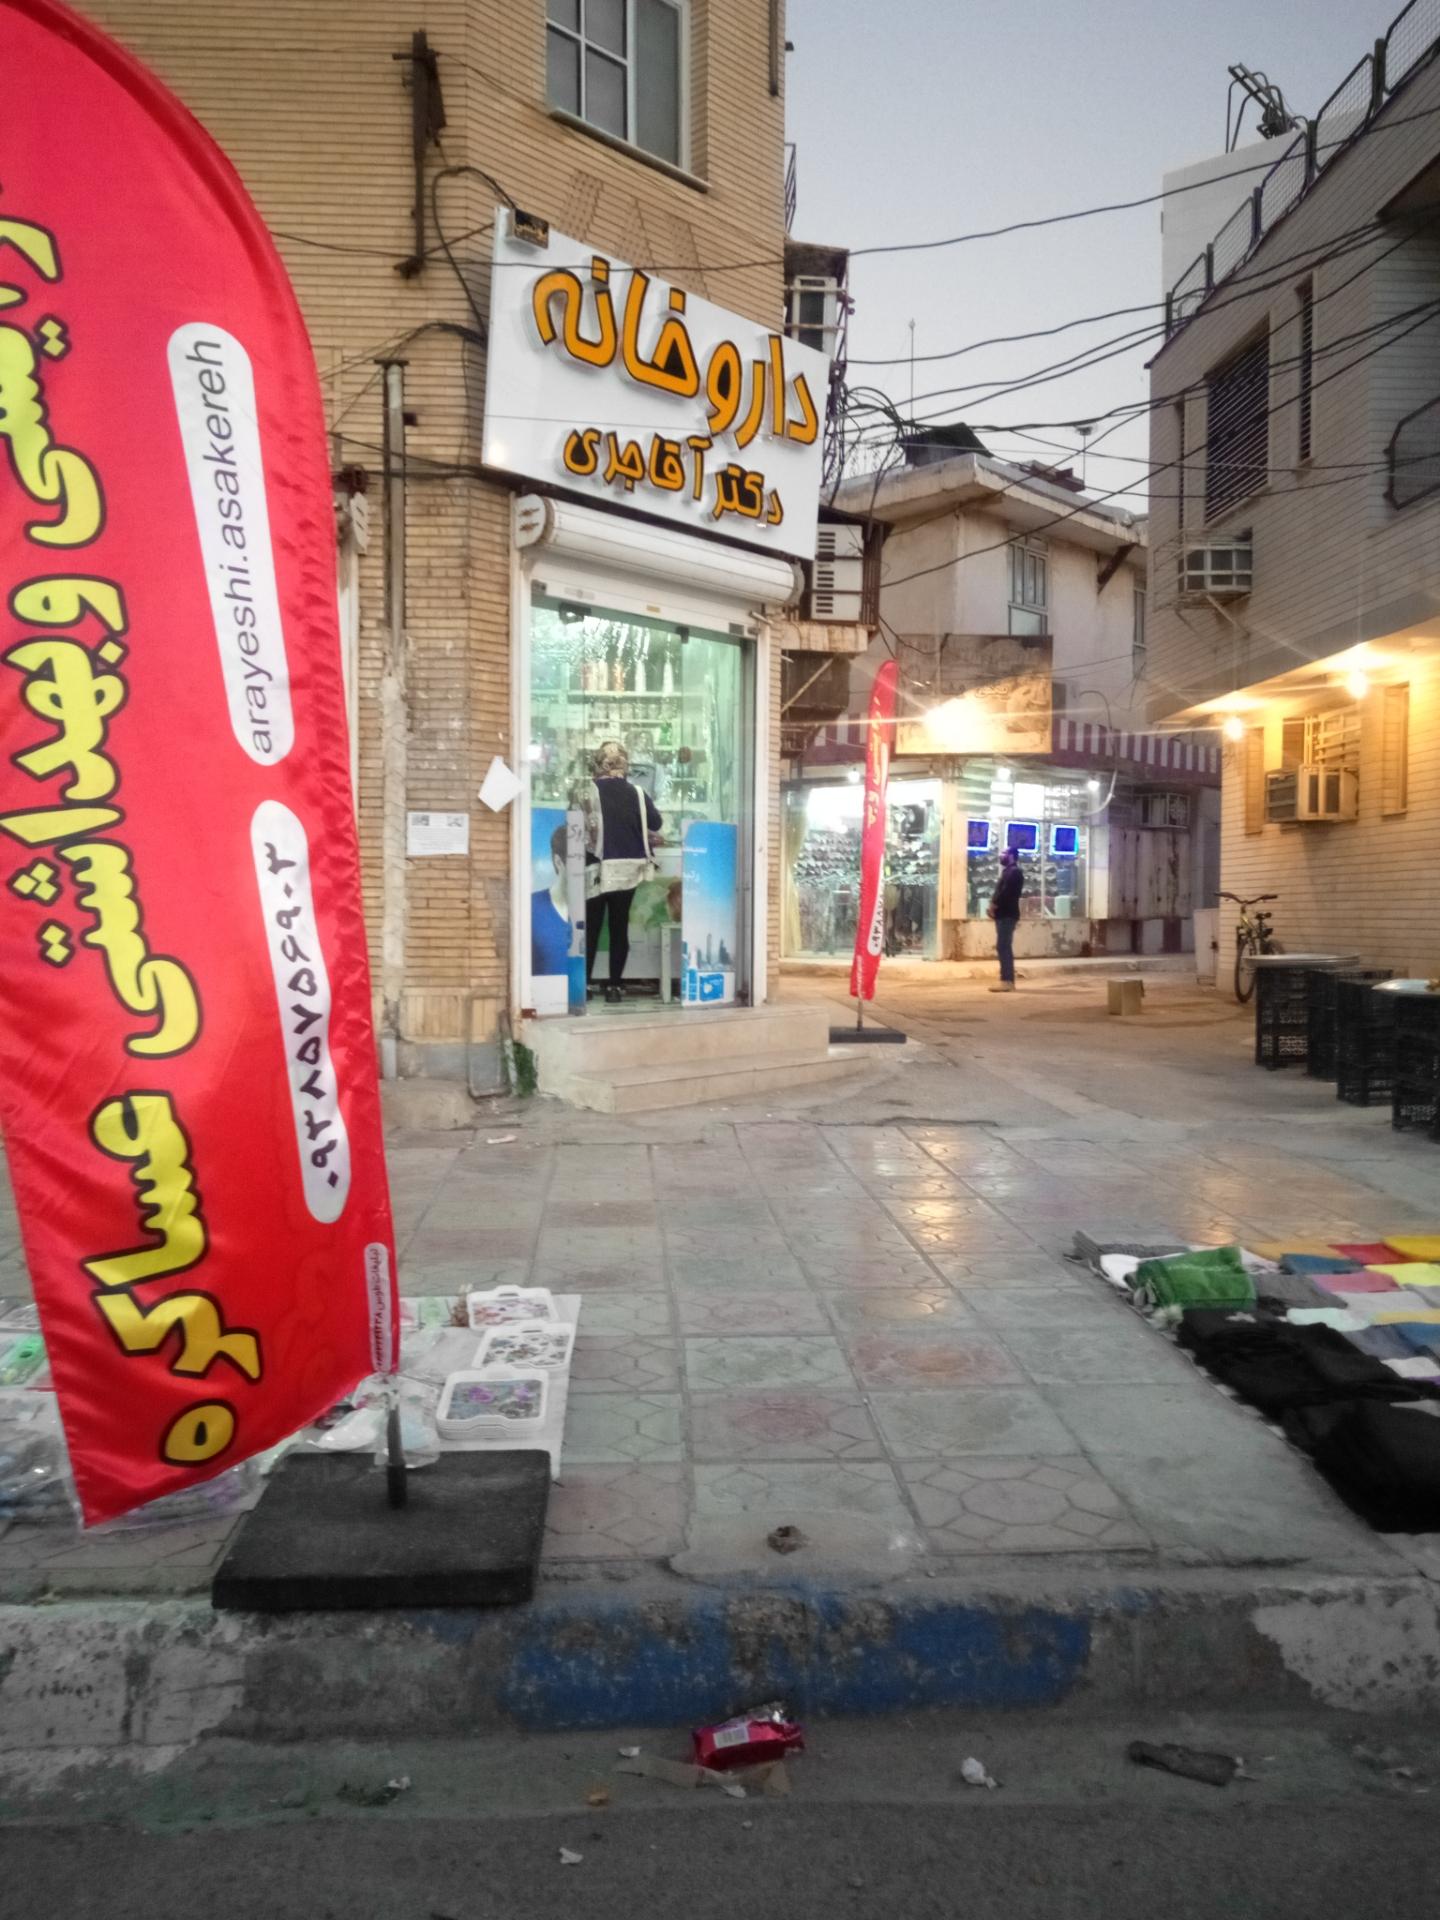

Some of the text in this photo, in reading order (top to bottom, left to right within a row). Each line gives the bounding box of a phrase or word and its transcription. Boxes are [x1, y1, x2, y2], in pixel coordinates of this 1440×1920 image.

[533, 255, 819, 446] داروخانه
[562, 427, 784, 525] دکتر آقاجری
[186, 339, 273, 755] arayeshi.asakereh
[264, 841, 340, 1188] ۰۹۳۸۵۷۵۶۹۰۳
[81, 1088, 264, 1468] عساکره
